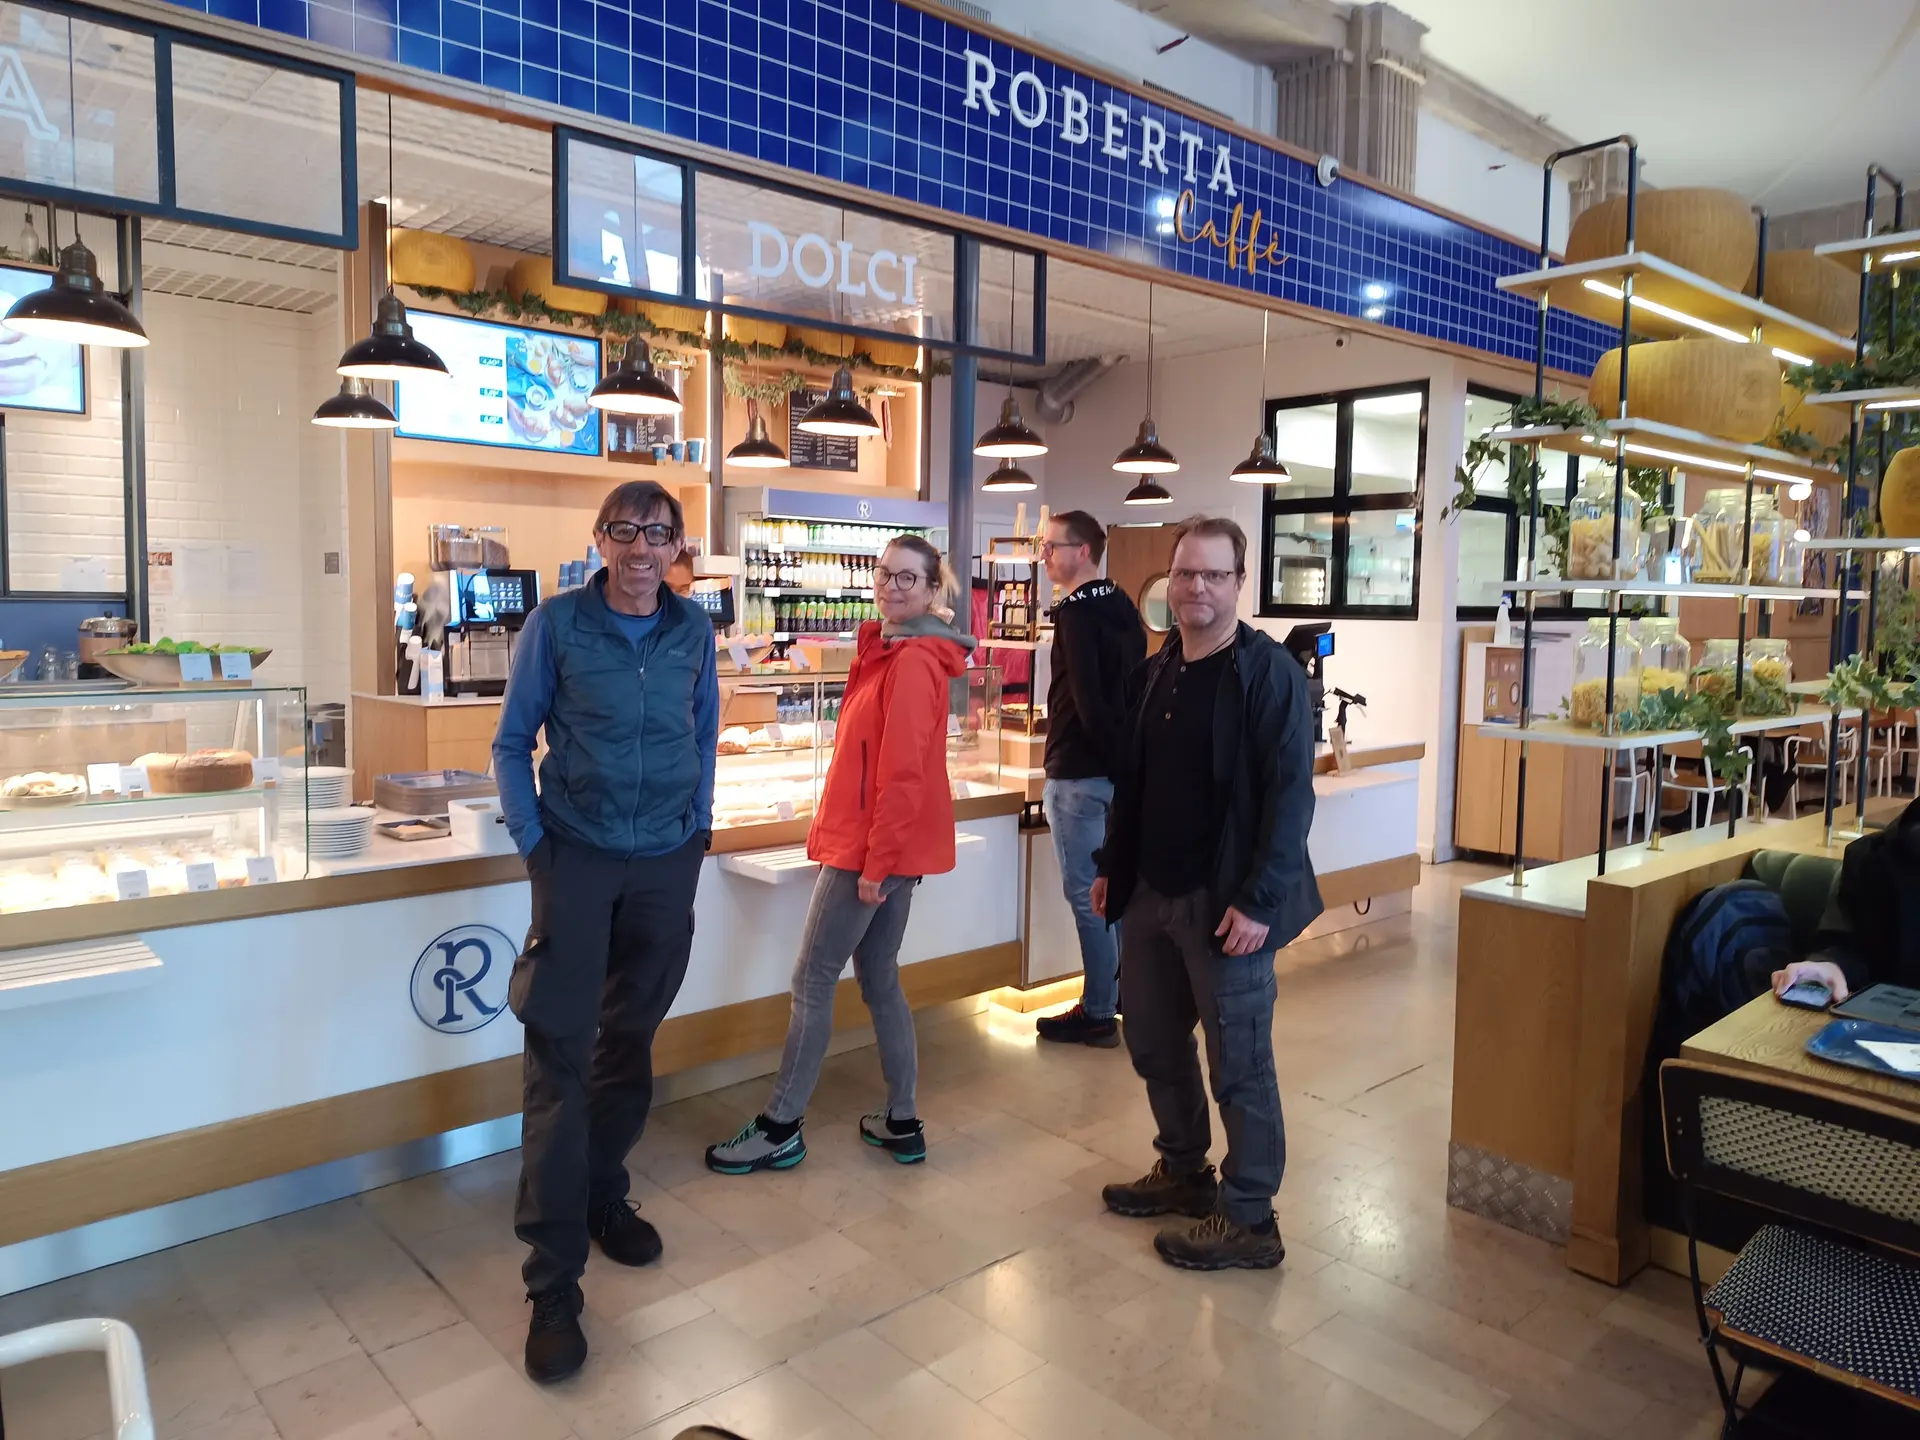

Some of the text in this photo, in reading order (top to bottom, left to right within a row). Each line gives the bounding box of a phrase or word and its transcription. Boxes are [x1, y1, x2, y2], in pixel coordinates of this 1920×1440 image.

[963, 49, 1237, 197] ROBERTA
[747, 221, 918, 305] DOLCI
[434, 937, 498, 1026] R
